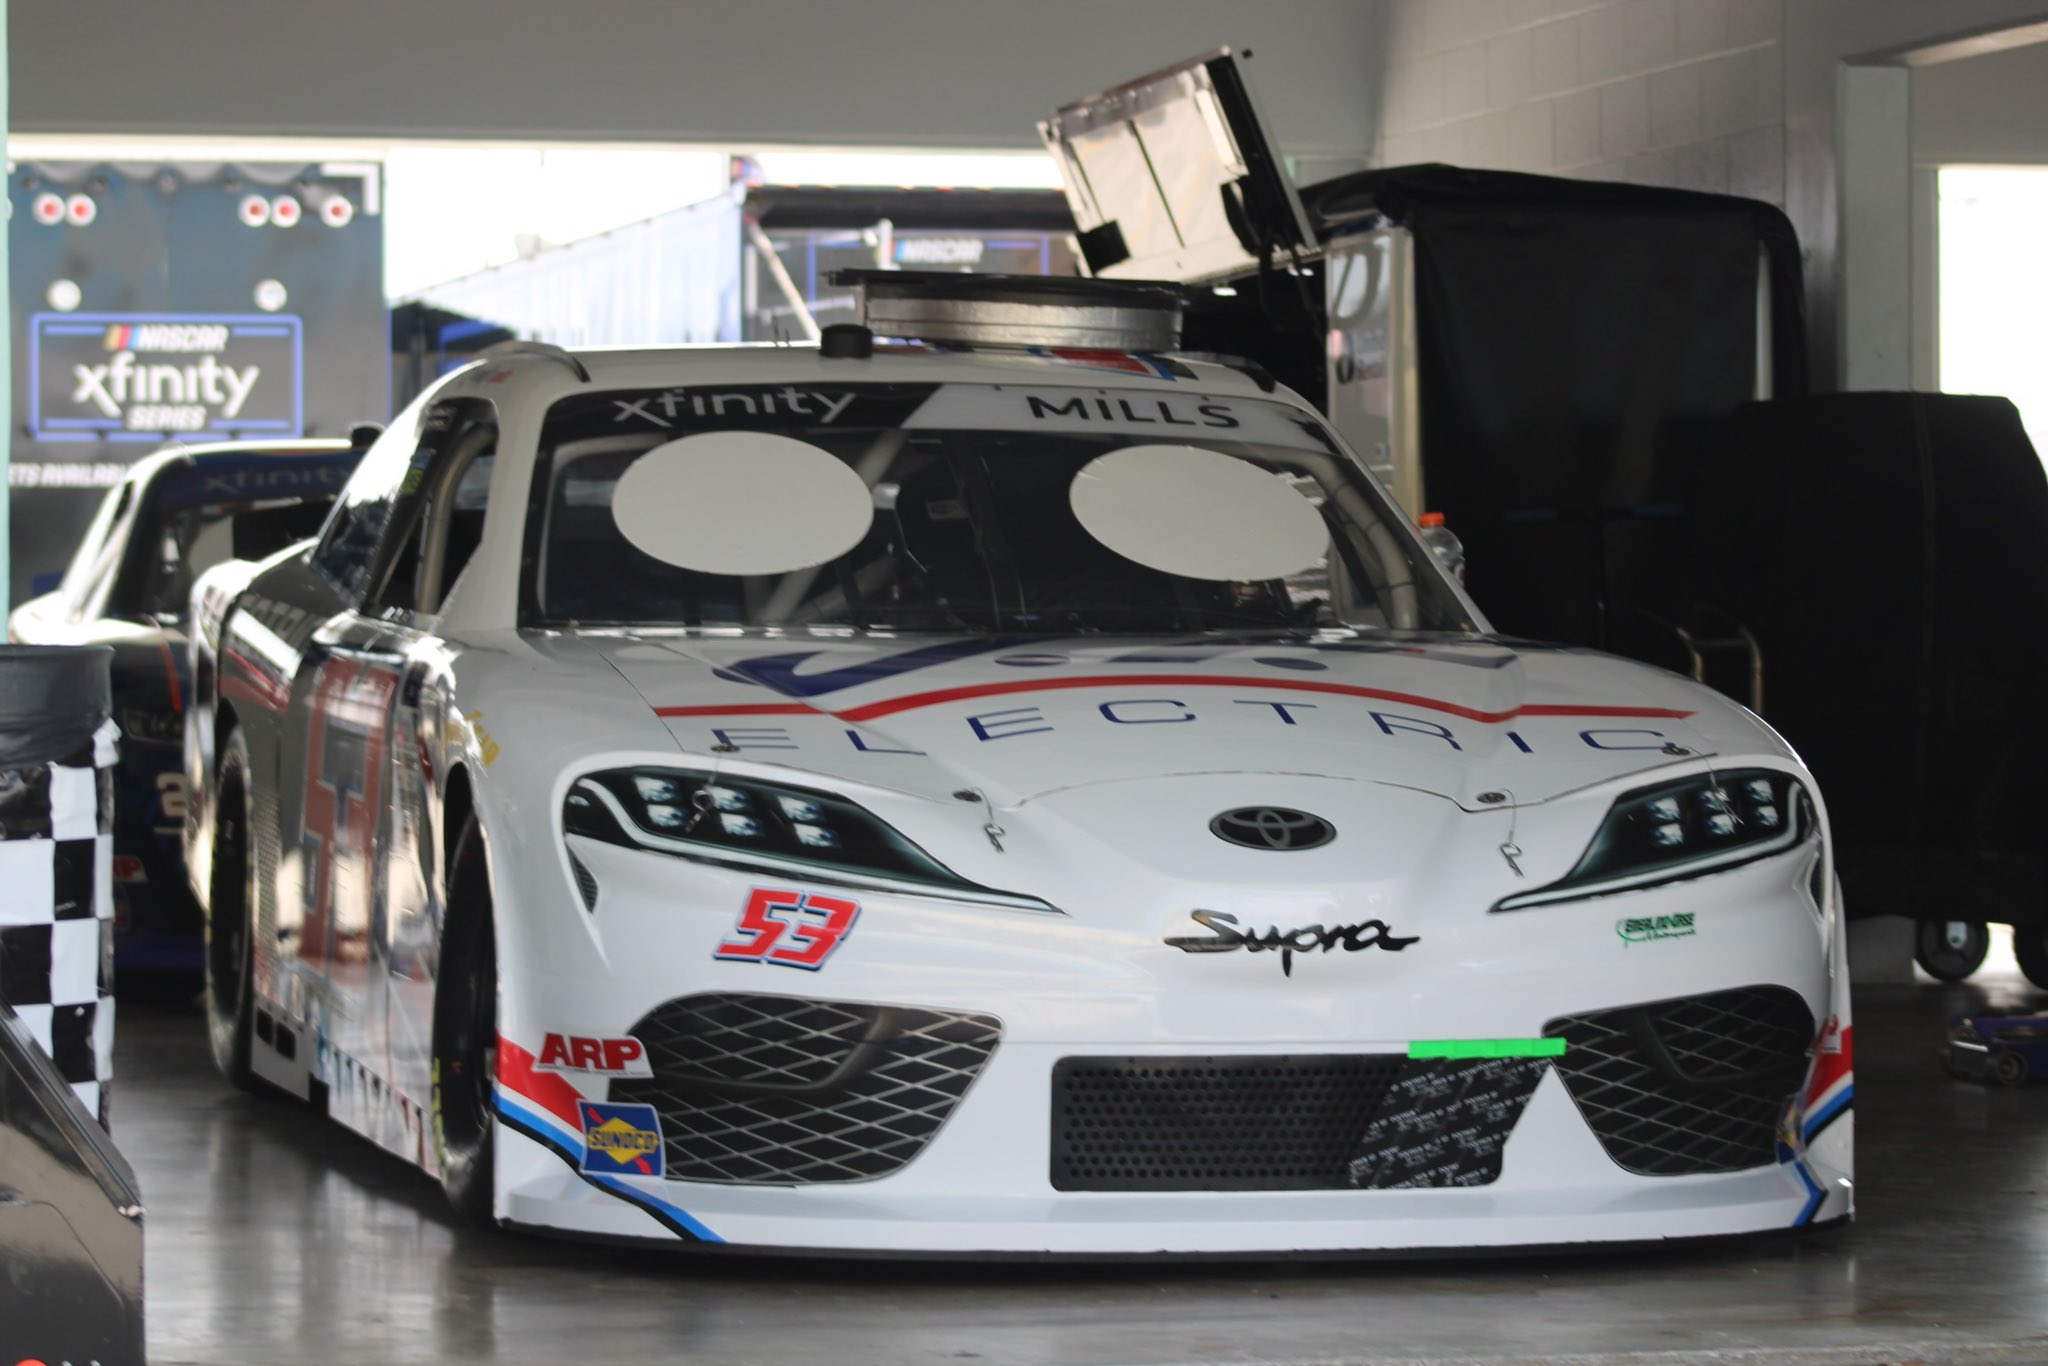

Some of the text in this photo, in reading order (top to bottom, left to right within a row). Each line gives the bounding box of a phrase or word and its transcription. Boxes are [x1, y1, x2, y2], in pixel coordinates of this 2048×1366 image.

[134, 325, 229, 351] NASCAR
[72, 352, 261, 418] xfinity
[126, 405, 207, 431] SERIES
[613, 386, 857, 428] xfinity
[1026, 395, 1241, 429] MILLS
[204, 466, 350, 497] xfinit
[710, 699, 1672, 756] ELECTRIC
[712, 884, 862, 971] 53
[1163, 908, 1421, 978] Supra
[539, 1031, 642, 1071] ARP
[588, 1129, 657, 1156] SUNOCO
